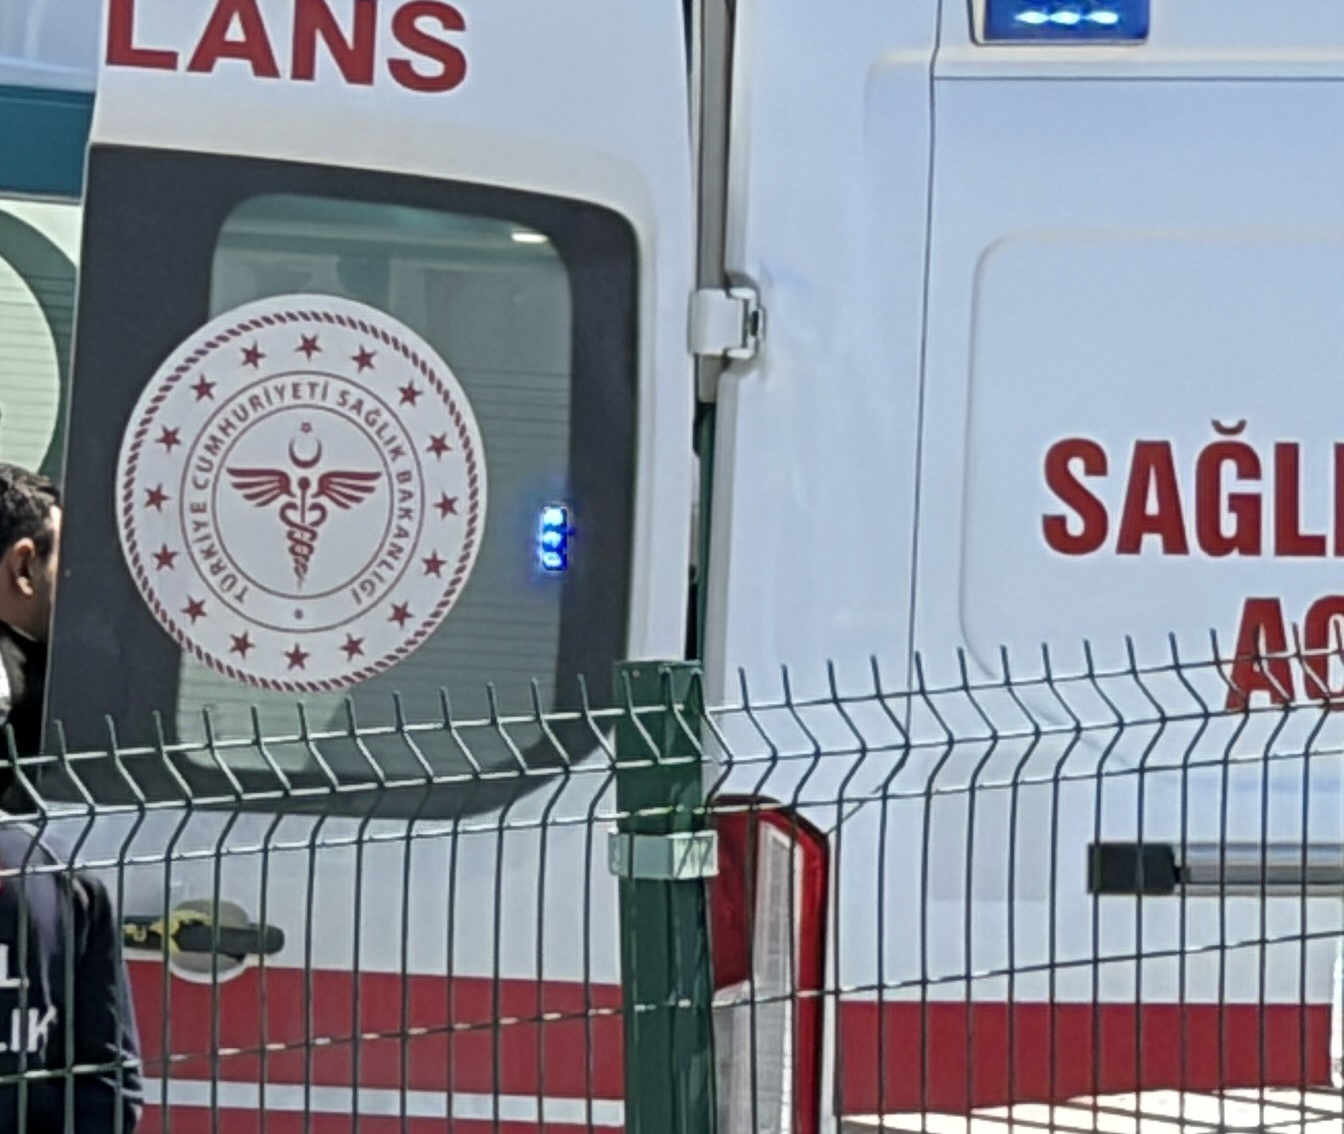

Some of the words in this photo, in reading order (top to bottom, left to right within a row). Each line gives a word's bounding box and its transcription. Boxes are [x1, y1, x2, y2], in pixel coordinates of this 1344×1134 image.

[191, 380, 330, 491] CUMHURİYETİ
[335, 388, 407, 463] SAĞLIK
[190, 501, 250, 604] TÜRKİYE
